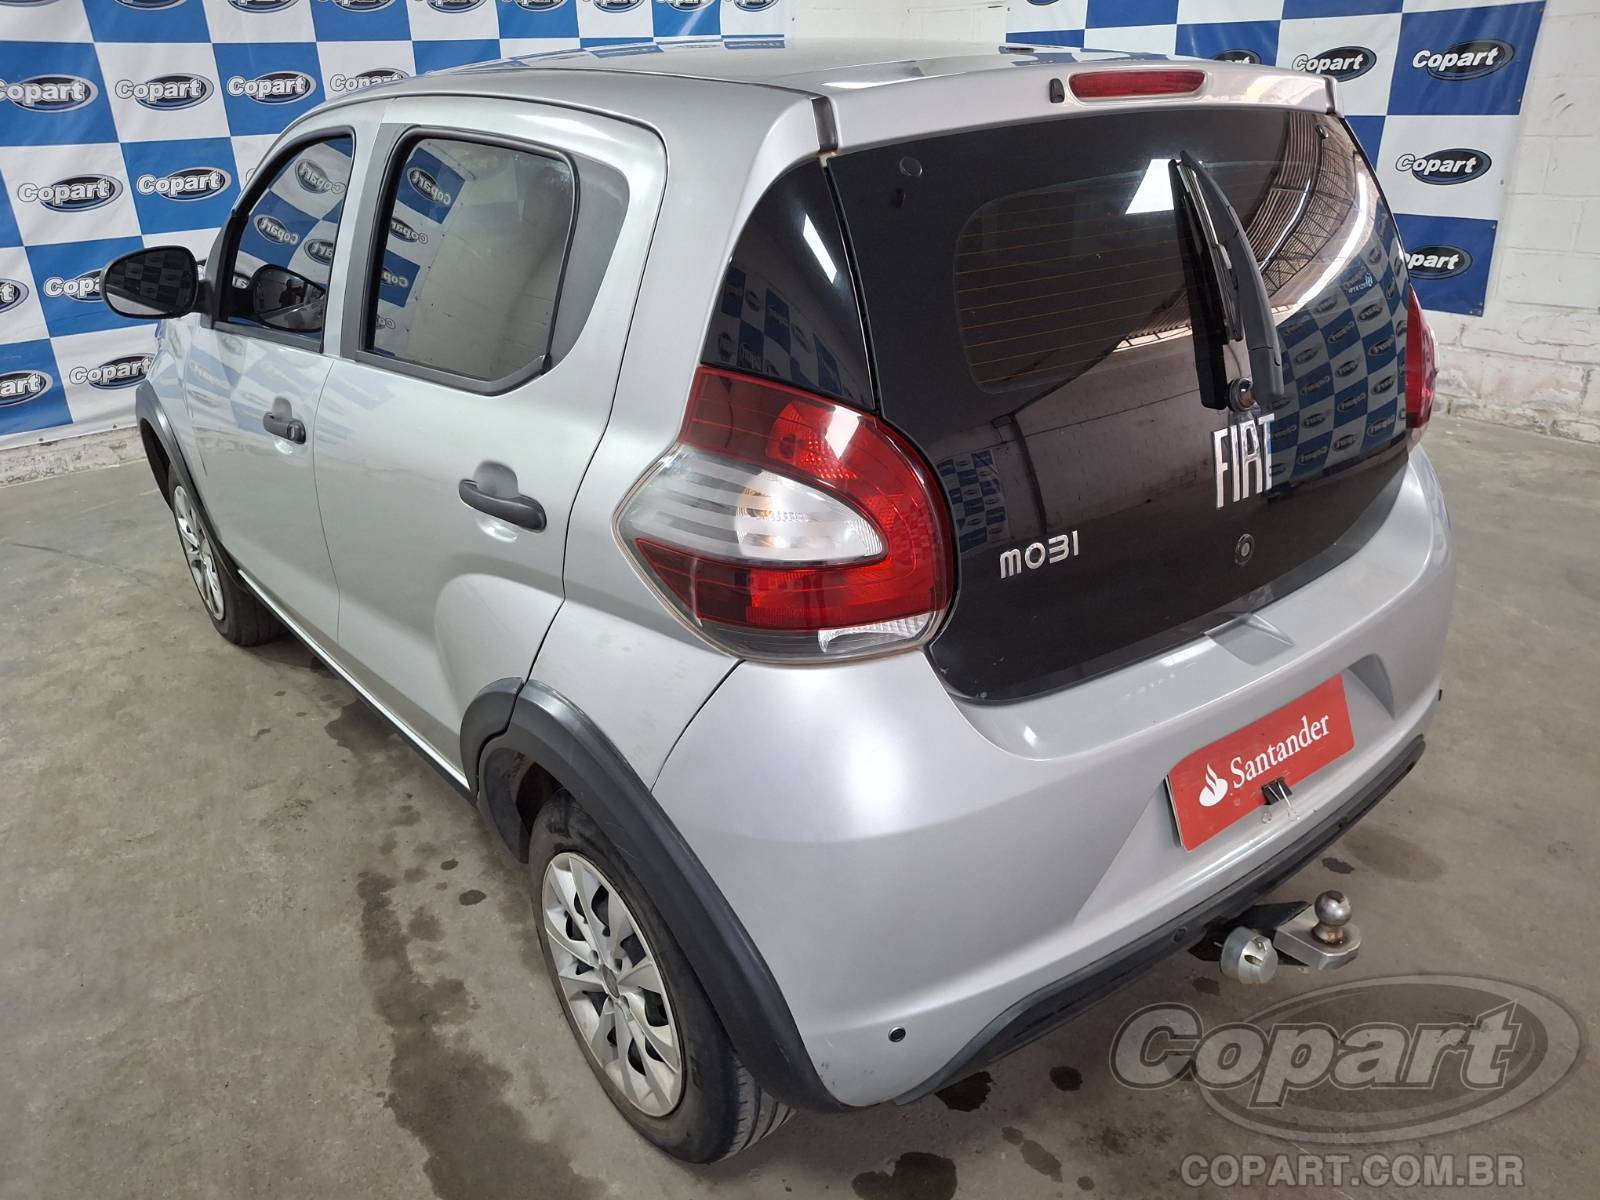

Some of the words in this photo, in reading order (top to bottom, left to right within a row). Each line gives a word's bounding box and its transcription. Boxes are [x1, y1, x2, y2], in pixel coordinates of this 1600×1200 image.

[1292, 52, 1364, 74] Copart
[1413, 47, 1499, 71] Copart
[116, 78, 201, 102] Copart
[229, 75, 306, 99] Copart
[1395, 154, 1477, 176] Copart
[18, 178, 111, 206] Copart
[138, 170, 220, 196] Copart
[1212, 413, 1275, 510] FIAT
[1229, 712, 1330, 790] Santander
